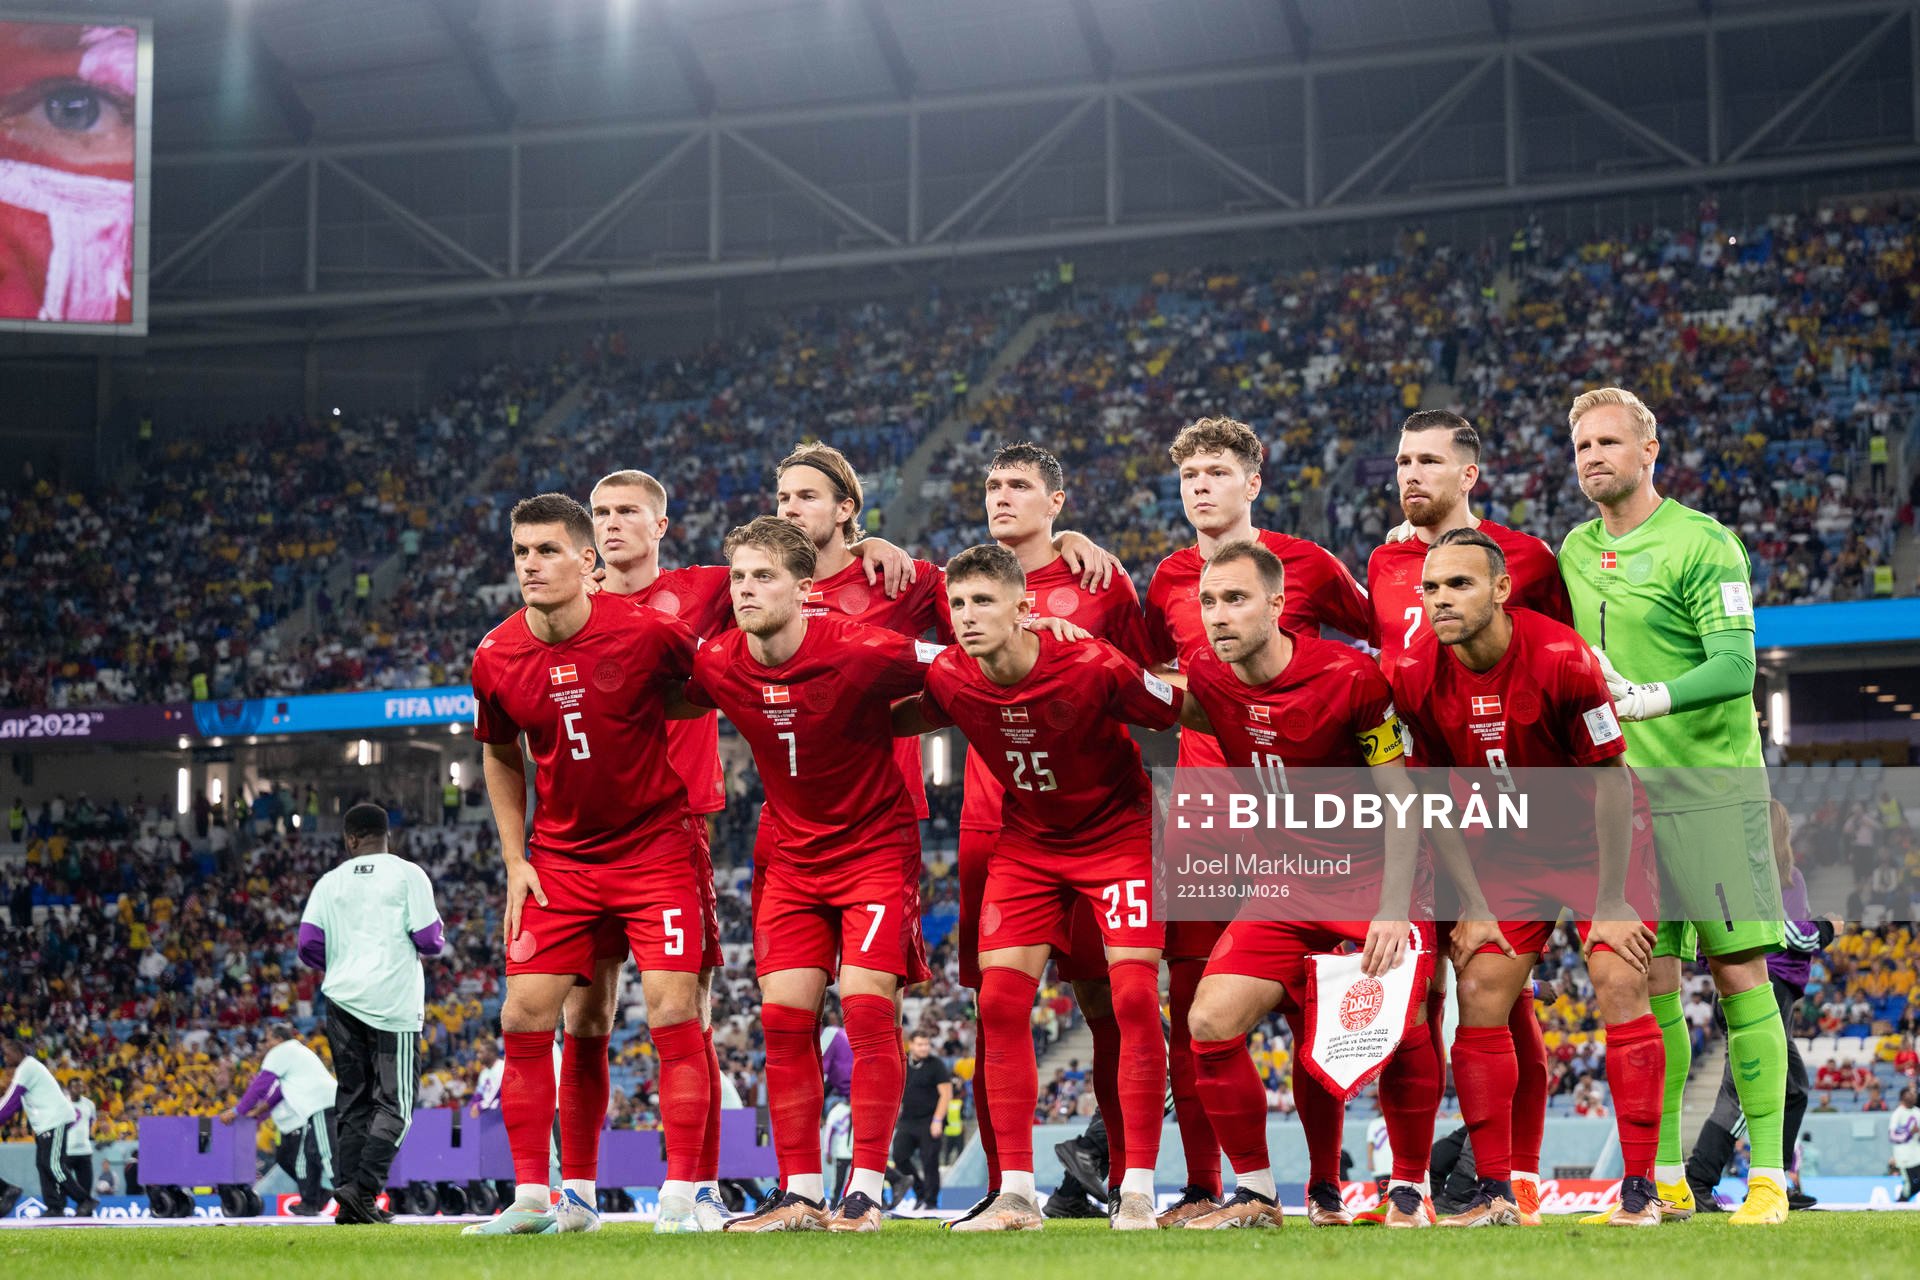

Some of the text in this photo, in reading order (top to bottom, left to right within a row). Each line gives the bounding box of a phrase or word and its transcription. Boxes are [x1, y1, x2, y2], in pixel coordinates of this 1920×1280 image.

[385, 697, 432, 719] FIFA
[563, 711, 591, 760] 5
[778, 732, 797, 776] 7
[1006, 751, 1058, 791] 25
[1251, 752, 1290, 799] 10
[1486, 749, 1517, 792] 9
[860, 904, 886, 952] 7
[1102, 880, 1148, 929] 25
[1715, 883, 1734, 932] 1
[662, 908, 684, 955] 5
[1348, 995, 1374, 1012] DBU
